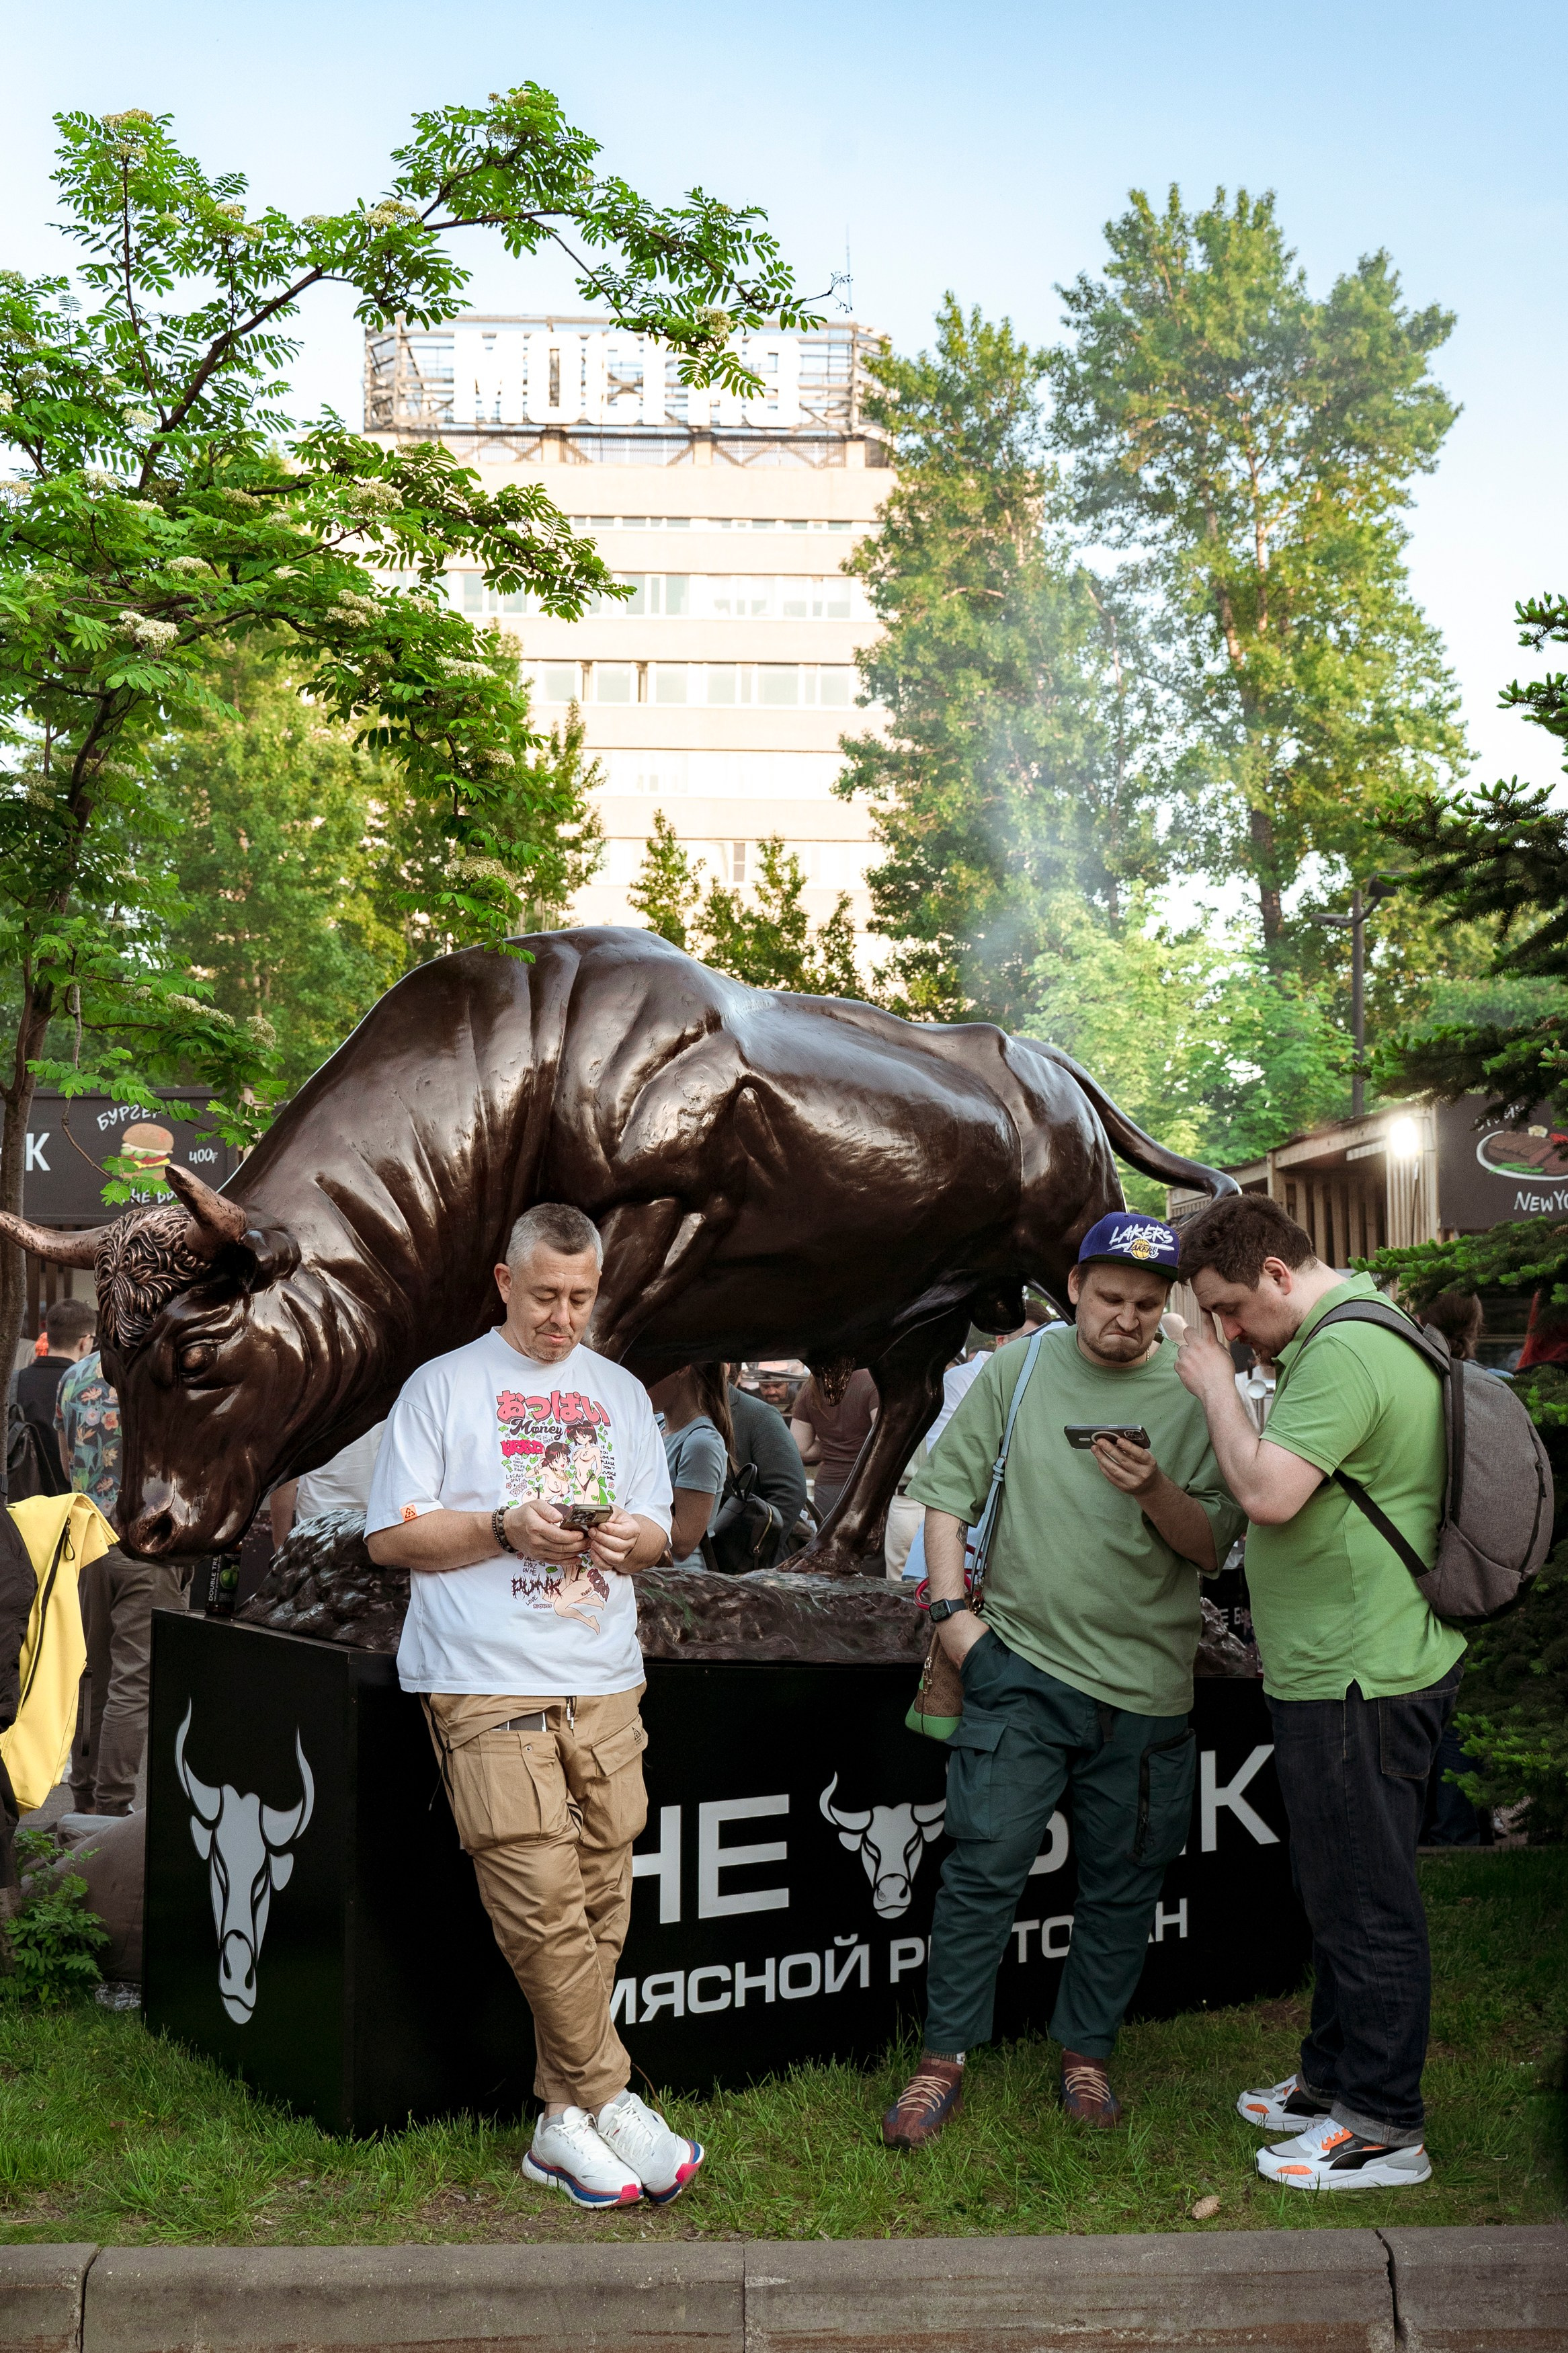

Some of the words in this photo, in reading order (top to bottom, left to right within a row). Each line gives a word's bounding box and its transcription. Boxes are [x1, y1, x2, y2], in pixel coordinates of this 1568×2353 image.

[1109, 1224, 1173, 1244] LAKERS
[1126, 1242, 1159, 1257] LAKERS
[509, 1419, 563, 1440] Money
[208, 1572, 216, 1601] DOUBLE
[511, 1572, 563, 1600] PUNK
[526, 1595, 538, 1606] LOVE
[889, 1897, 1188, 1984] РТОН
